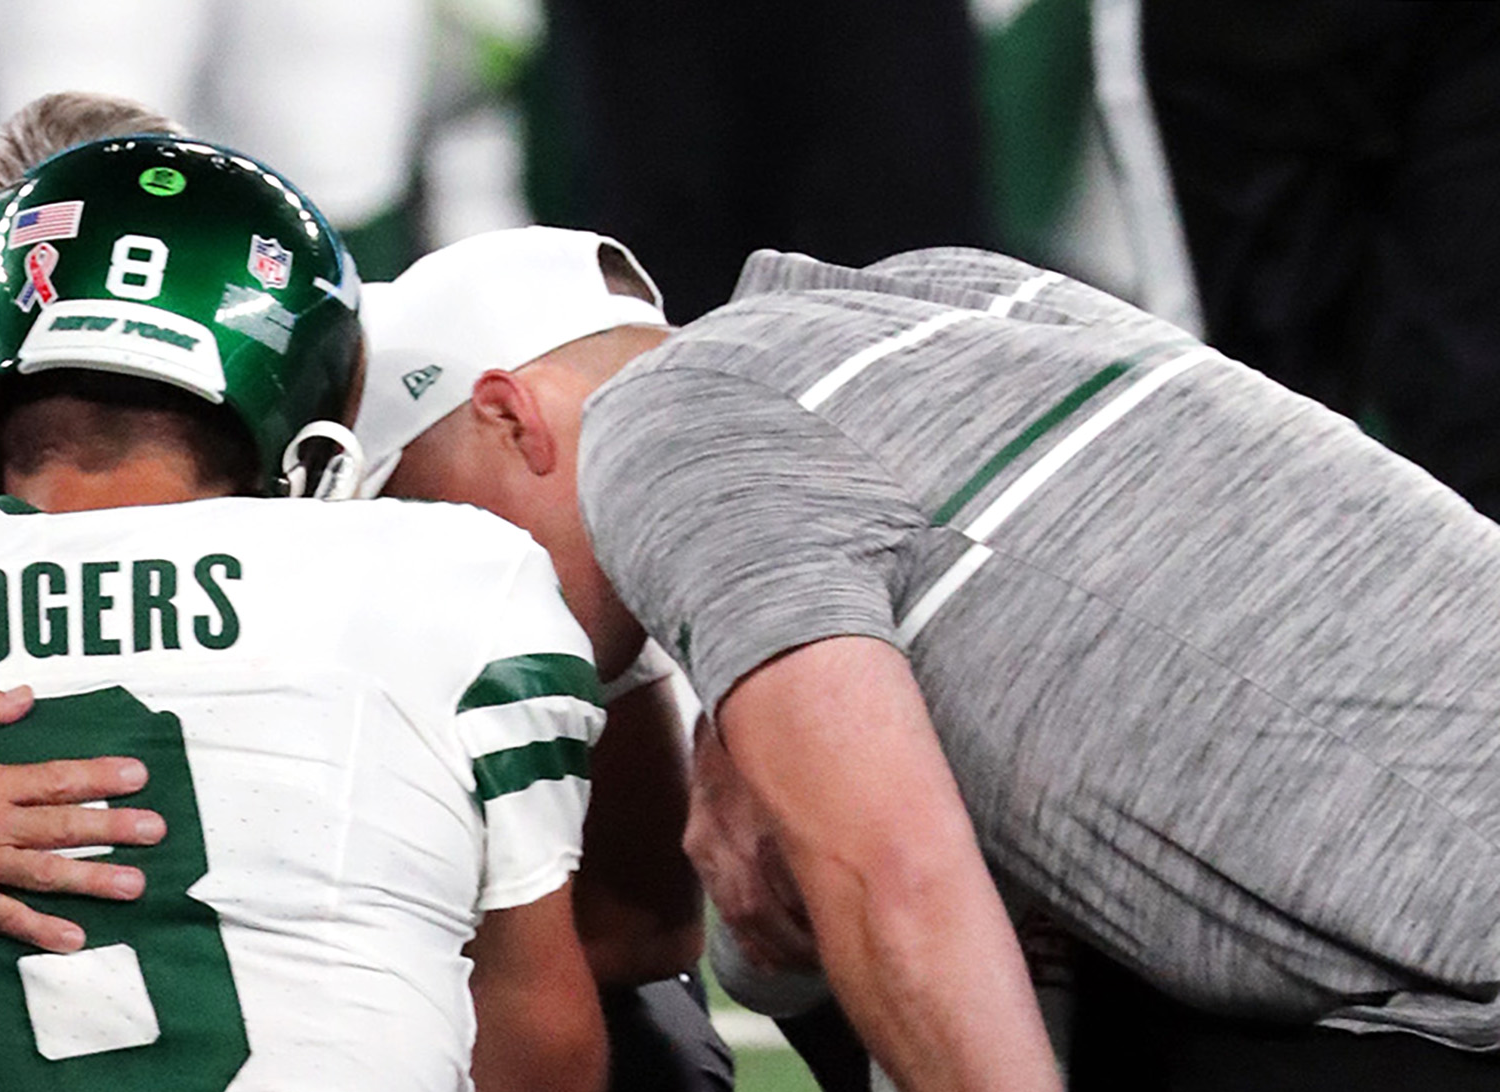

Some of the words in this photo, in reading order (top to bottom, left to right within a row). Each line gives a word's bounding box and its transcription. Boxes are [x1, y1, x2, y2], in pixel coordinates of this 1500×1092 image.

[105, 234, 170, 301] 8
[49, 316, 117, 331] NEW
[122, 319, 200, 351] YORK
